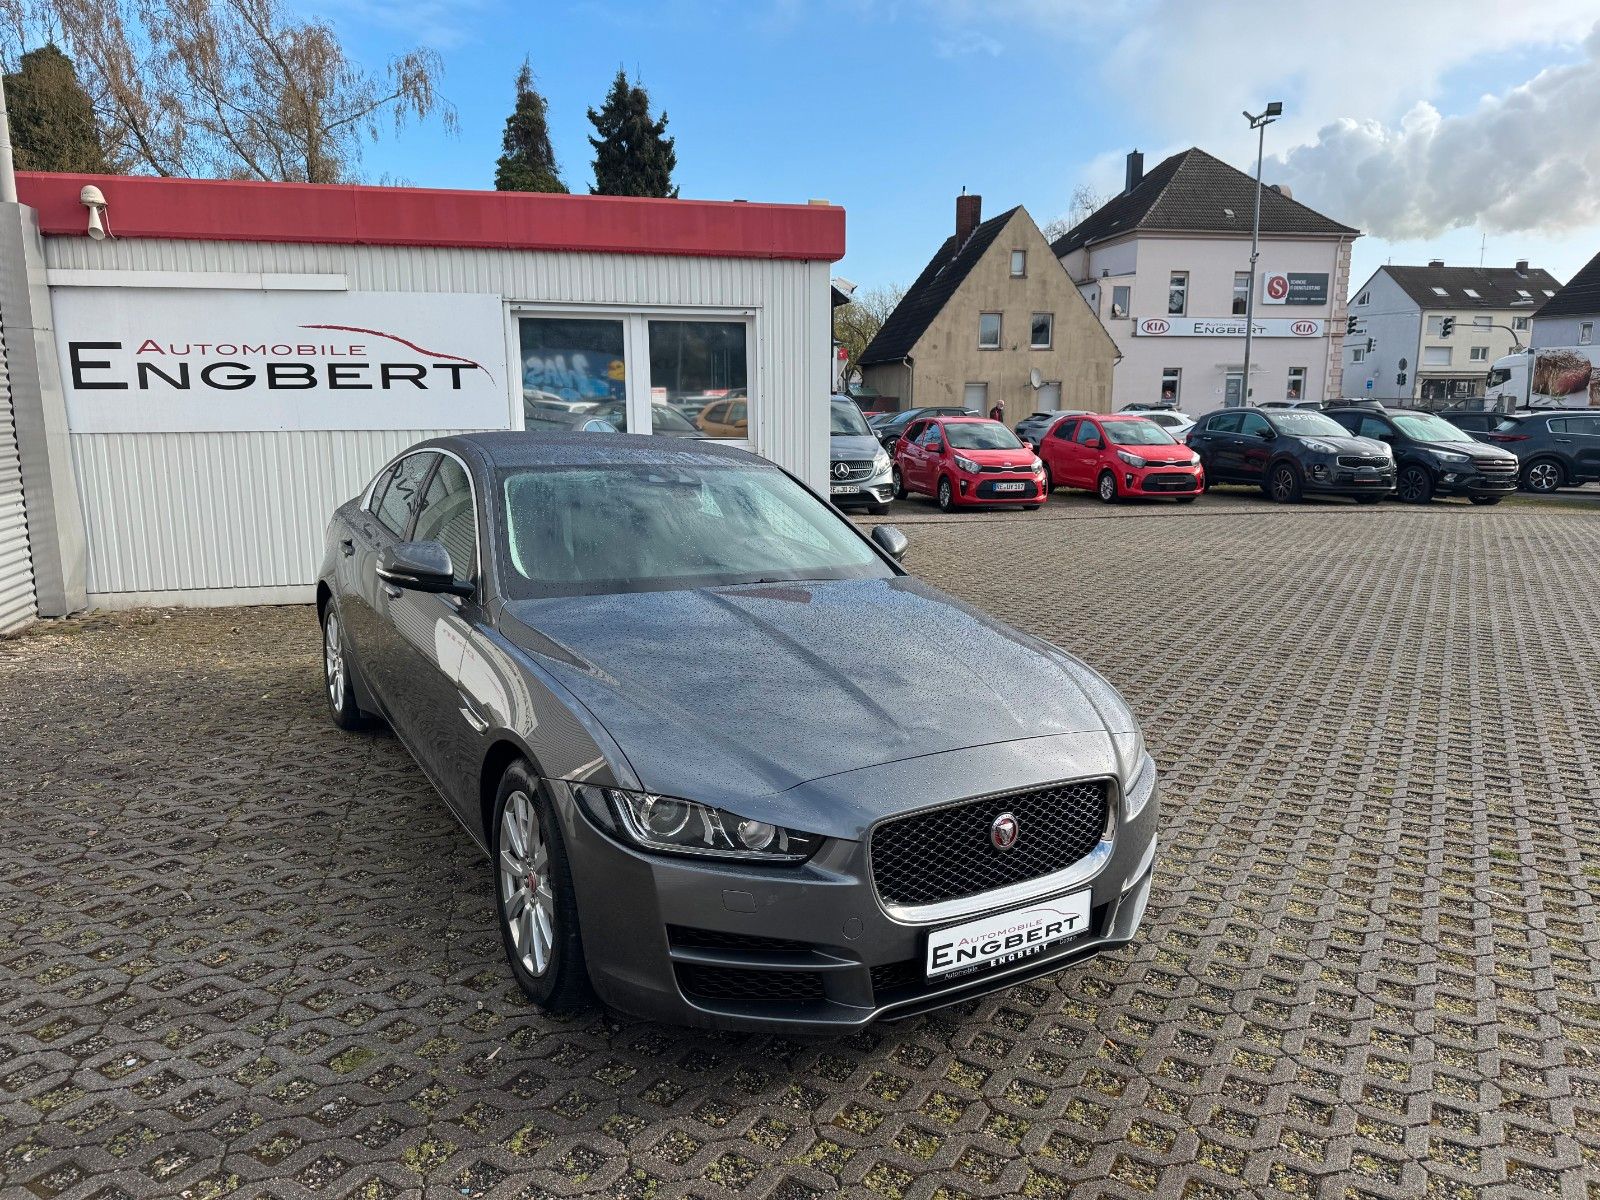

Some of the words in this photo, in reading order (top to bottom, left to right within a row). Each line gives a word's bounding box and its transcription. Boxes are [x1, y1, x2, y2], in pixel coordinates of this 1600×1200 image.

[1271, 279, 1283, 296] S
[1146, 322, 1165, 331] KIA
[1295, 324, 1314, 333] KIA
[136, 339, 367, 356] AUTOMOBILE
[68, 341, 478, 390] ENGBERT
[931, 915, 1080, 970] ENGBERT
[958, 918, 1043, 947] AUTOMOBILE
[990, 942, 1048, 967] ENGBERT
